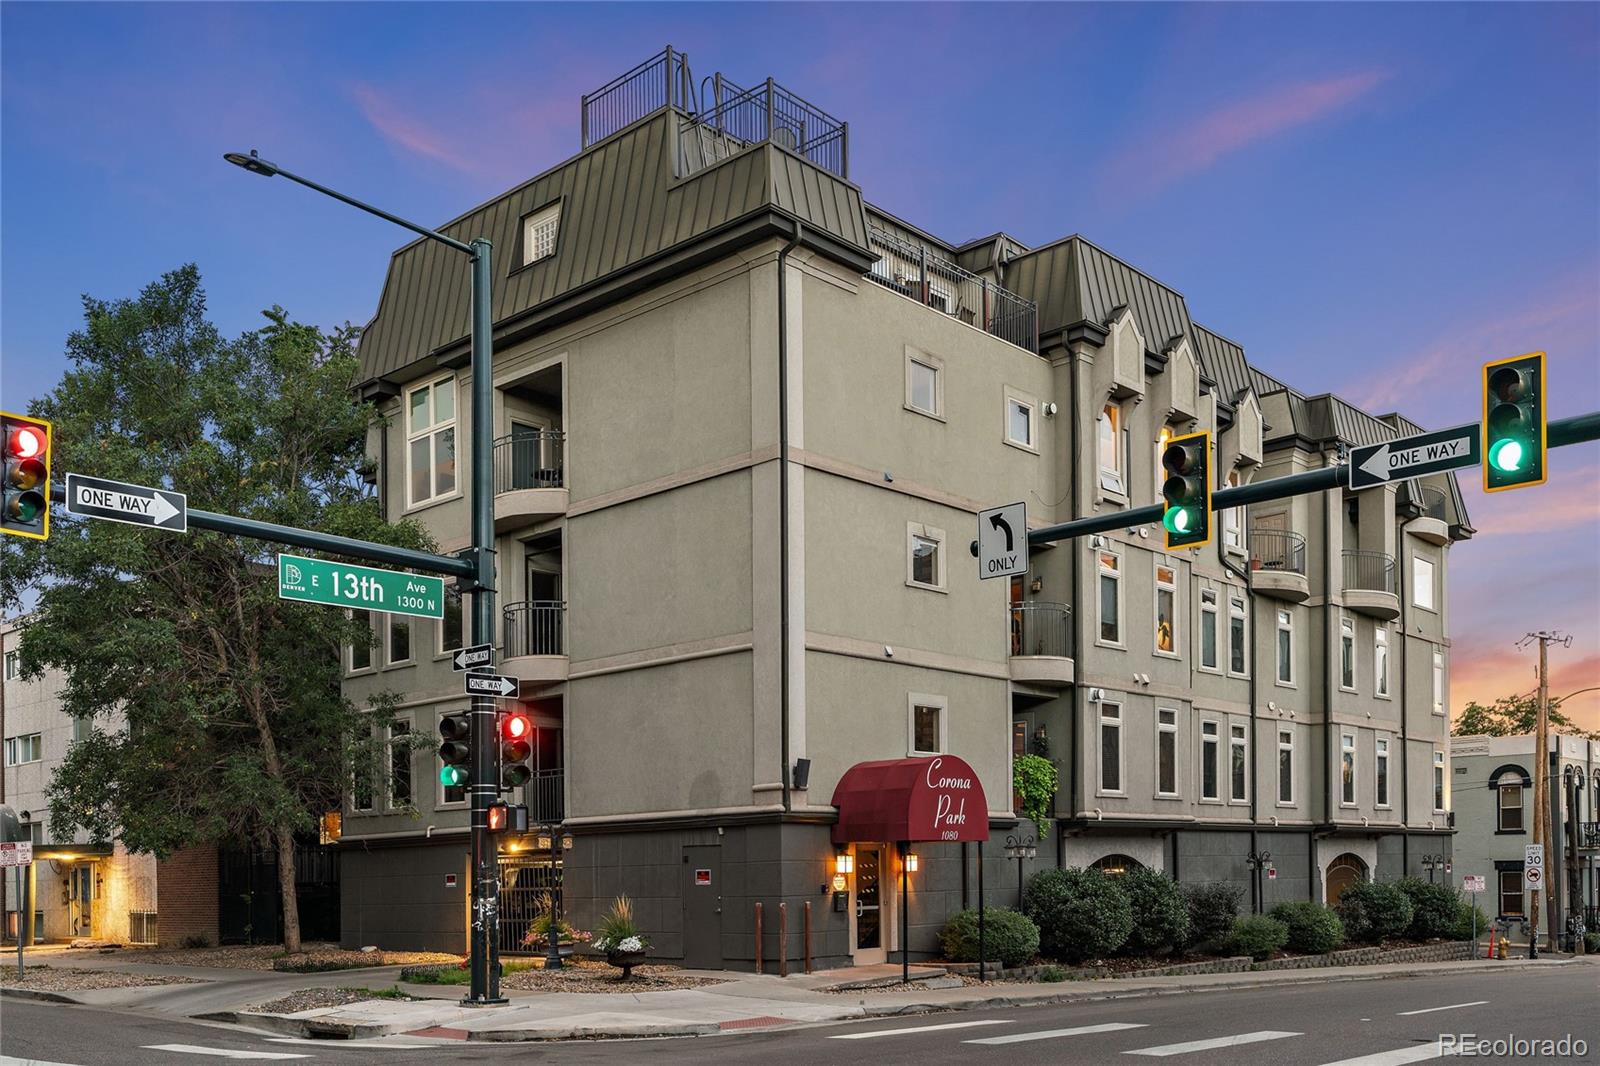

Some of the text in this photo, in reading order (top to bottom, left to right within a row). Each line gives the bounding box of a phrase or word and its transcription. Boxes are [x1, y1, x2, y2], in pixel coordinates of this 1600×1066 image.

[1389, 441, 1460, 467] ONE WAY
[81, 488, 151, 513] ONE WAY
[988, 555, 1018, 573] ONLY
[282, 583, 306, 592] DENVER
[311, 571, 384, 603] E 13th
[406, 581, 427, 594] Ave
[397, 595, 435, 611] 1300 N
[465, 651, 488, 663] ONE WAY
[470, 679, 502, 690] ONE WAY
[926, 758, 972, 789] Corona
[934, 794, 966, 828] Park
[941, 830, 959, 841] 1080
[1527, 855, 1541, 865] 30
